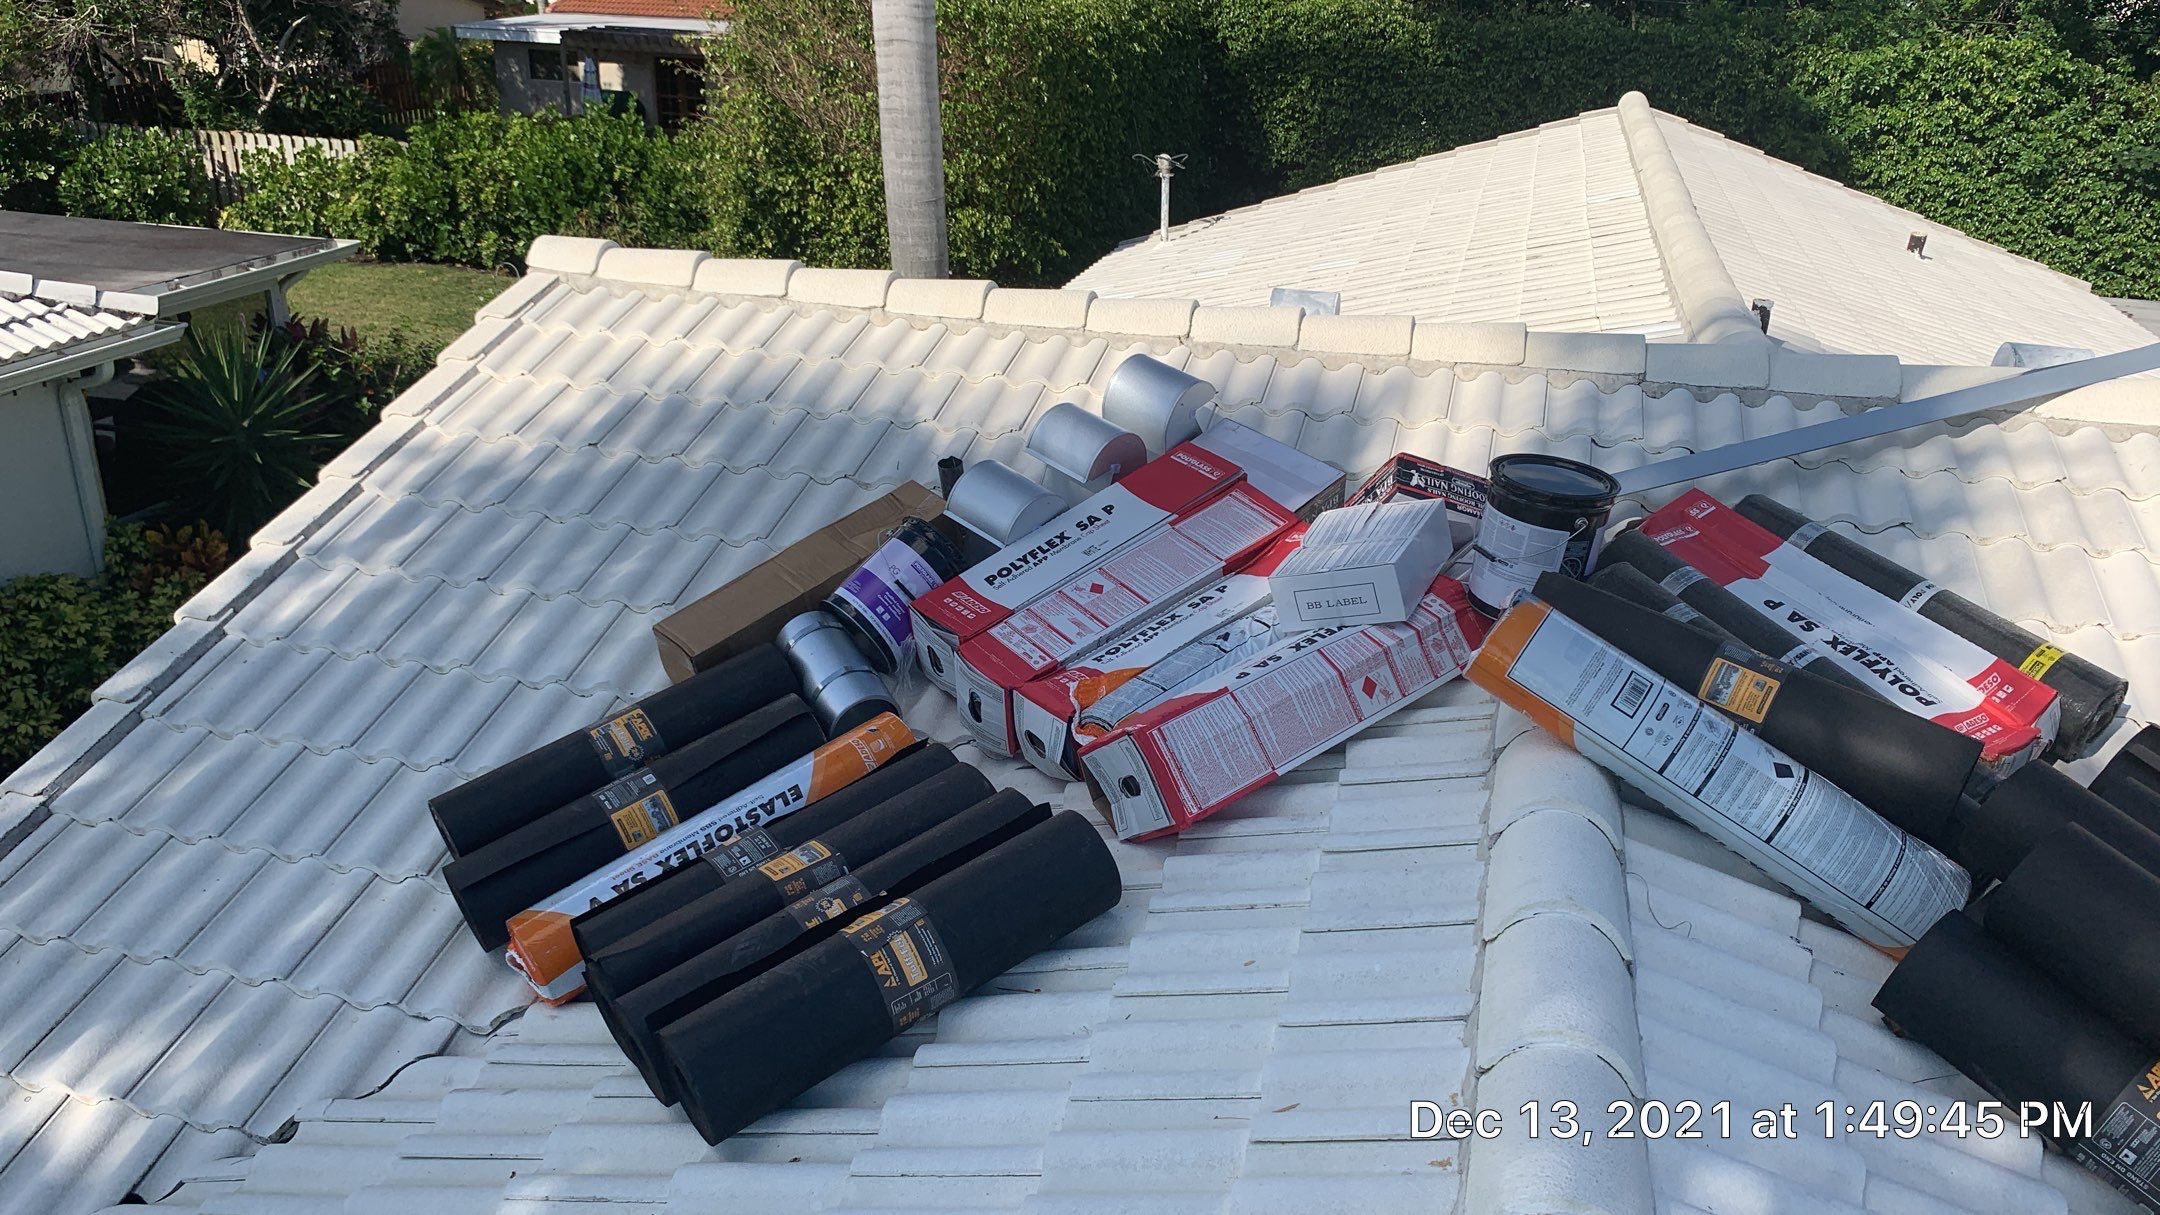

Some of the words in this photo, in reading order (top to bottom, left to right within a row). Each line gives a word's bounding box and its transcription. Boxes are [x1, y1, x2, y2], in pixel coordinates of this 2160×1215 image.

[1420, 475, 1449, 491] NAILS
[1451, 482, 1487, 501] OOFING
[984, 531, 1072, 587] POLYFLEX
[1076, 514, 1102, 532] SA
[1101, 504, 1115, 516] P
[1033, 555, 1049, 568] APP
[1307, 601, 1323, 610] BB
[1327, 596, 1368, 608] LABEL
[1763, 599, 1786, 611] P
[1092, 613, 1183, 662] POLYFLEX
[1187, 595, 1215, 609] SA
[1214, 585, 1228, 593] P
[1787, 611, 1820, 632] SA
[1287, 624, 1350, 653] YFLEX
[1253, 654, 1283, 668] SA
[1872, 651, 1895, 666] APP
[1235, 671, 1251, 680] P
[1823, 634, 1939, 707] POLYFLEX
[655, 783, 804, 875] ELASTOFLEX
[611, 871, 648, 896] SA
[2125, 1169, 2149, 1191] STAND
